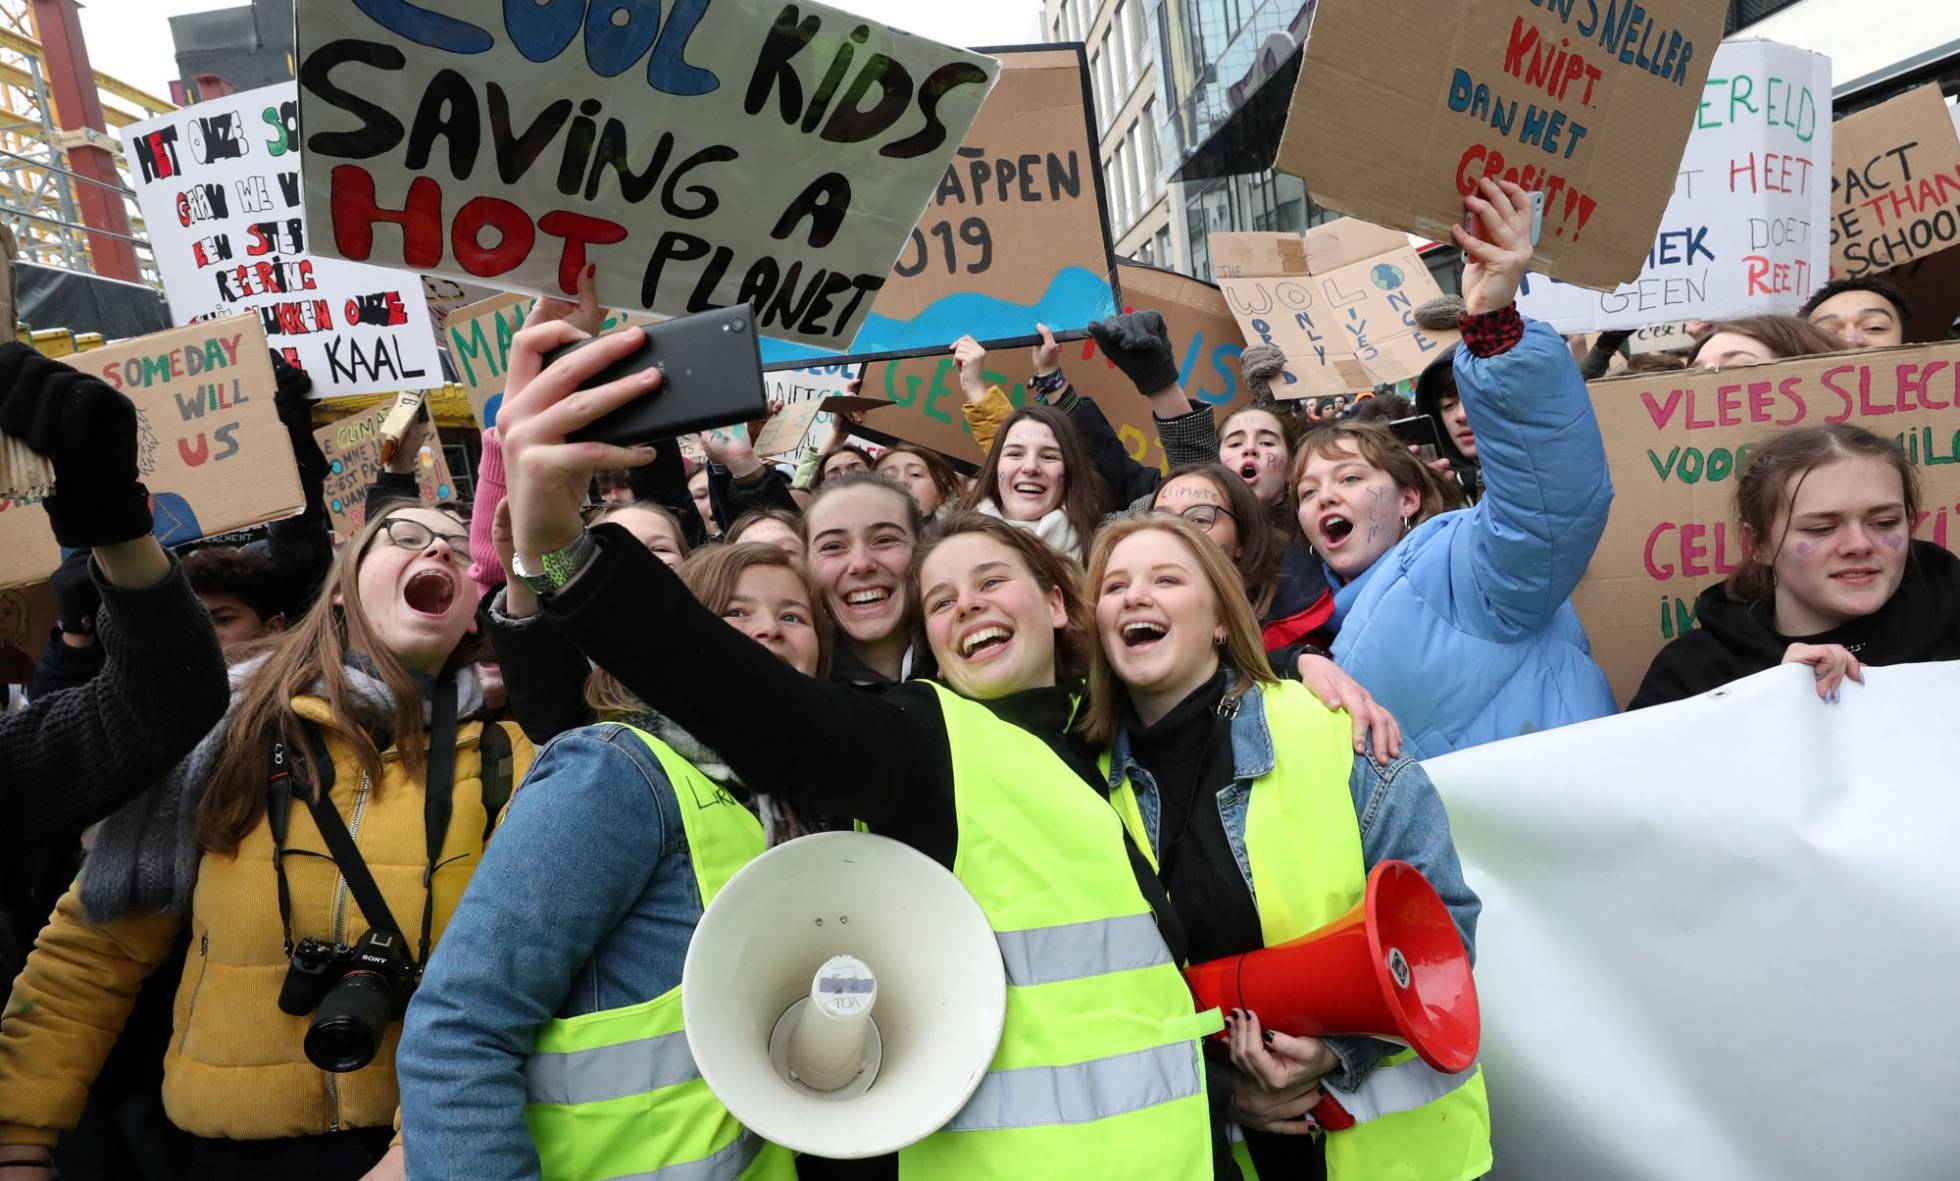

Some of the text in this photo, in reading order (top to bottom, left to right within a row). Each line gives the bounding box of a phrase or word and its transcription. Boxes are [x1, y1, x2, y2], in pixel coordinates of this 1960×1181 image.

[1448, 67, 1587, 159] DAN HET
[235, 175, 273, 214] WE
[929, 150, 1081, 206] APPEN
[1730, 152, 1813, 194] HEET
[1832, 142, 1918, 204] ACT
[770, 171, 852, 248] A
[1747, 217, 1811, 252] DOET
[193, 233, 232, 269] EEN
[330, 164, 886, 337] HOT PLANET
[1843, 203, 1960, 275] SCHOO
[1600, 268, 1708, 314] GEEN
[103, 333, 243, 390] SOMEDAY
[324, 333, 425, 385] KAAL
[174, 379, 249, 421] WILL
[1640, 360, 1960, 432] VLEES SLEC
[177, 421, 240, 467] US
[362, 954, 387, 964] SONY
